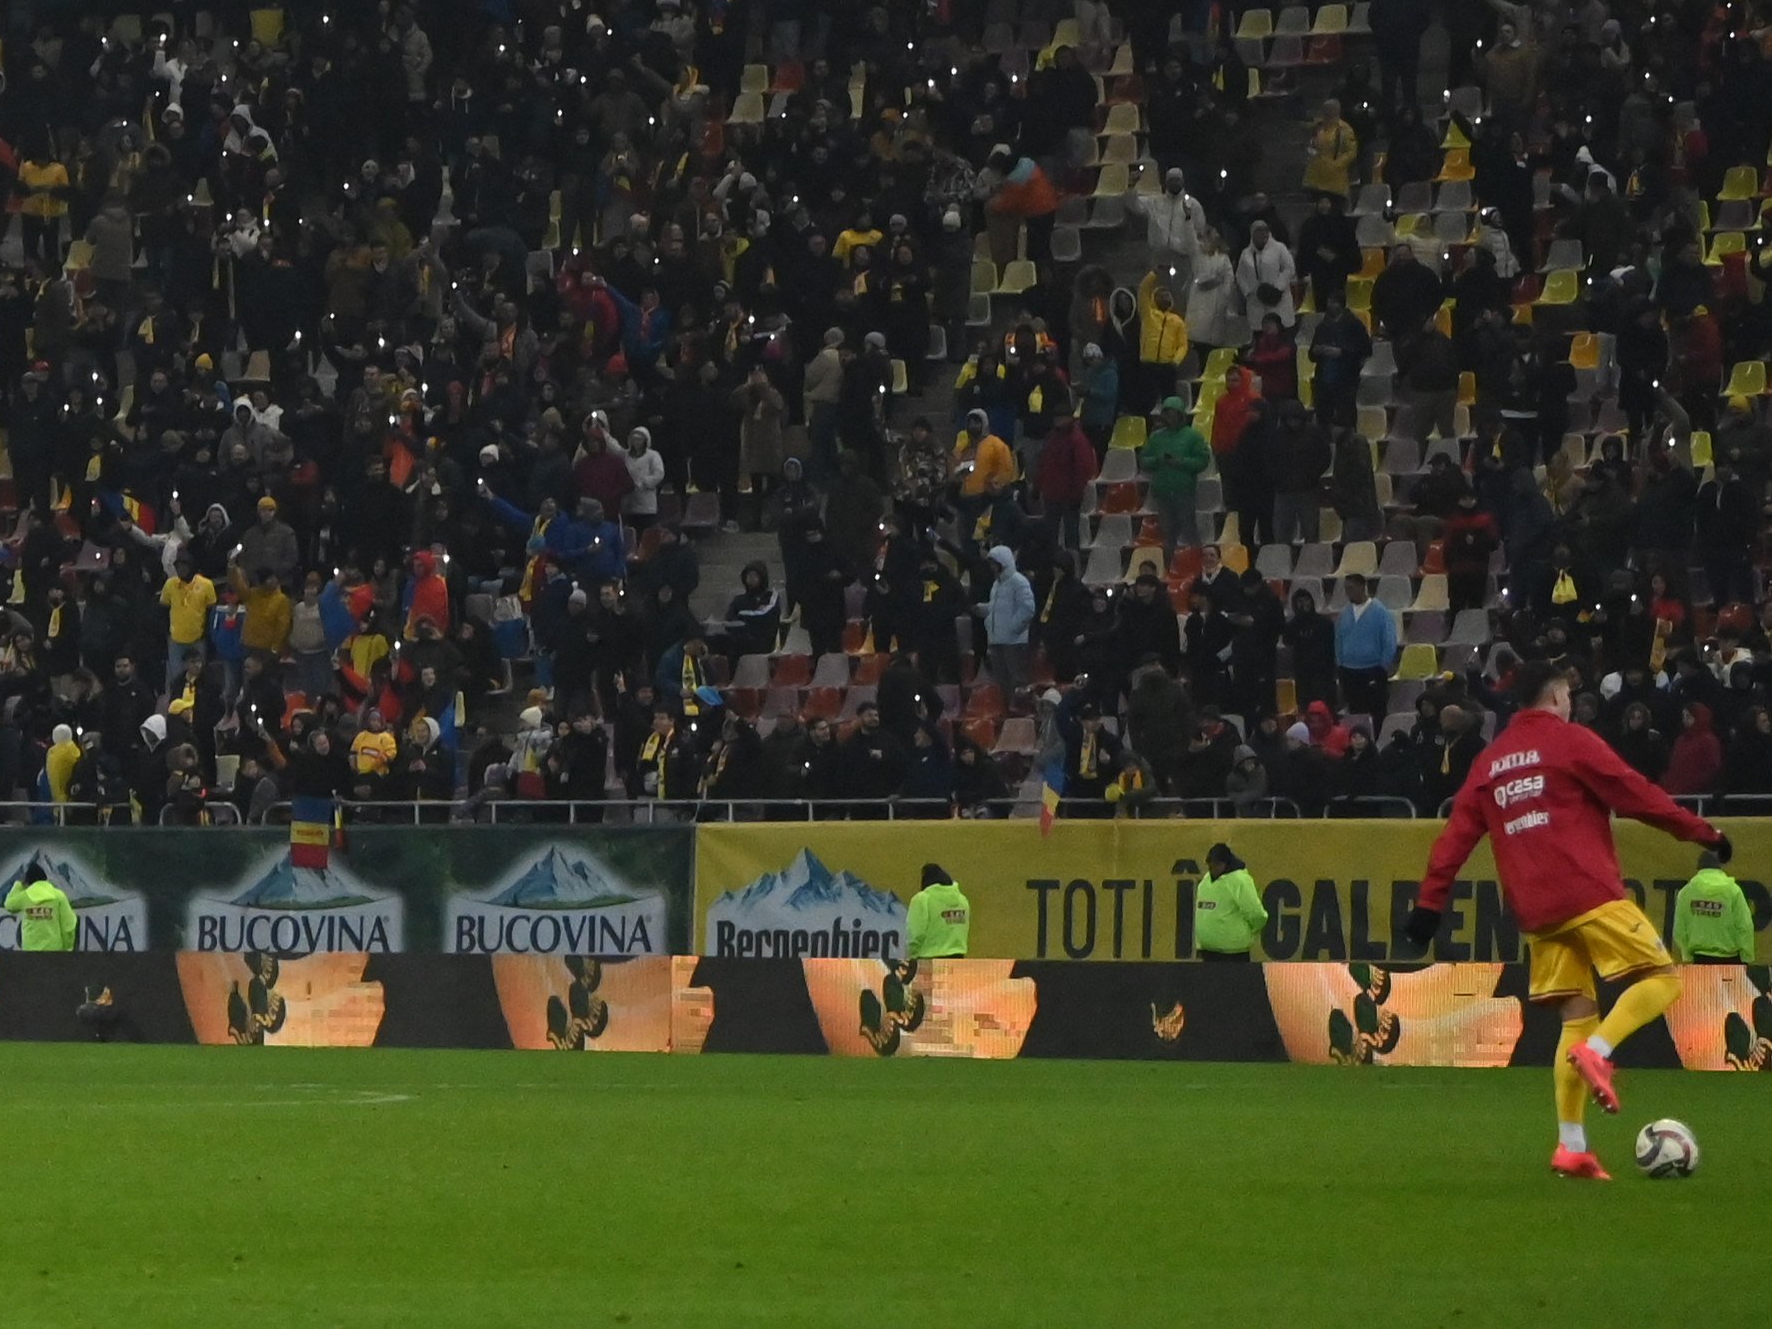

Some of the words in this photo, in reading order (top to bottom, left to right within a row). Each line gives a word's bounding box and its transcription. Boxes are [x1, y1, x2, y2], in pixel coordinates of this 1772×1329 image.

[1506, 775, 1544, 795] casa
[198, 914, 390, 954] BUCOVINA
[457, 914, 652, 953] BUCOVINA
[1026, 878, 1153, 959] TOTI
